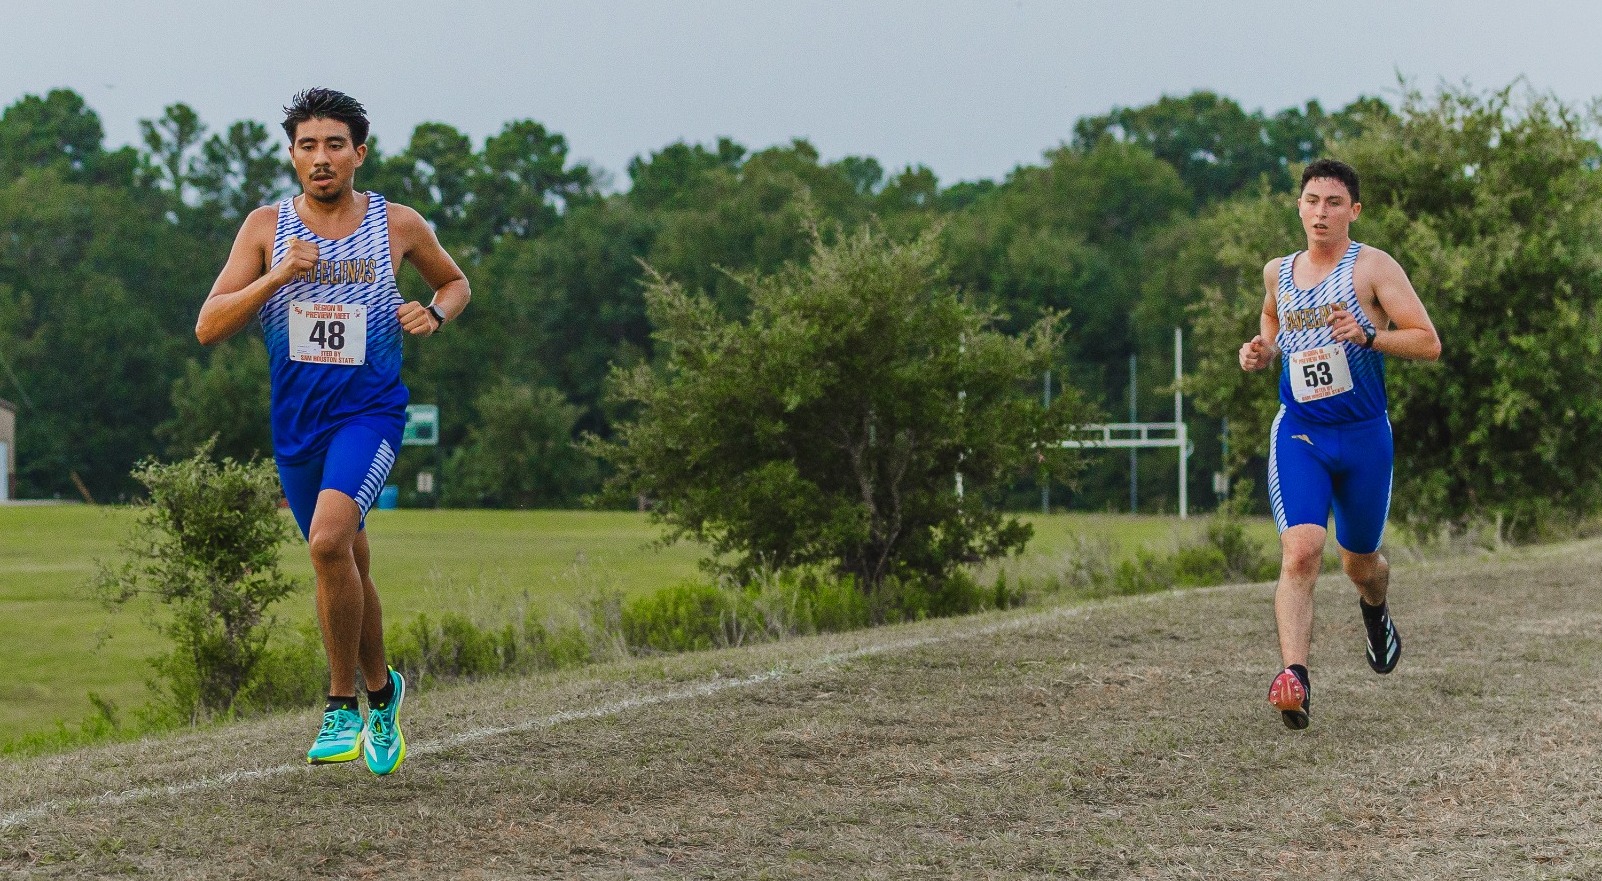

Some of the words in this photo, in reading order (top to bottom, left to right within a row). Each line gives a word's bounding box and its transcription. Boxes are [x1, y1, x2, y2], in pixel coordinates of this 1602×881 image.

[296, 258, 376, 284] AVELINAS
[306, 311, 333, 319] PREVIEW
[309, 320, 345, 350] 48
[313, 355, 337, 363] HOUSTON
[1302, 361, 1333, 388] 53
